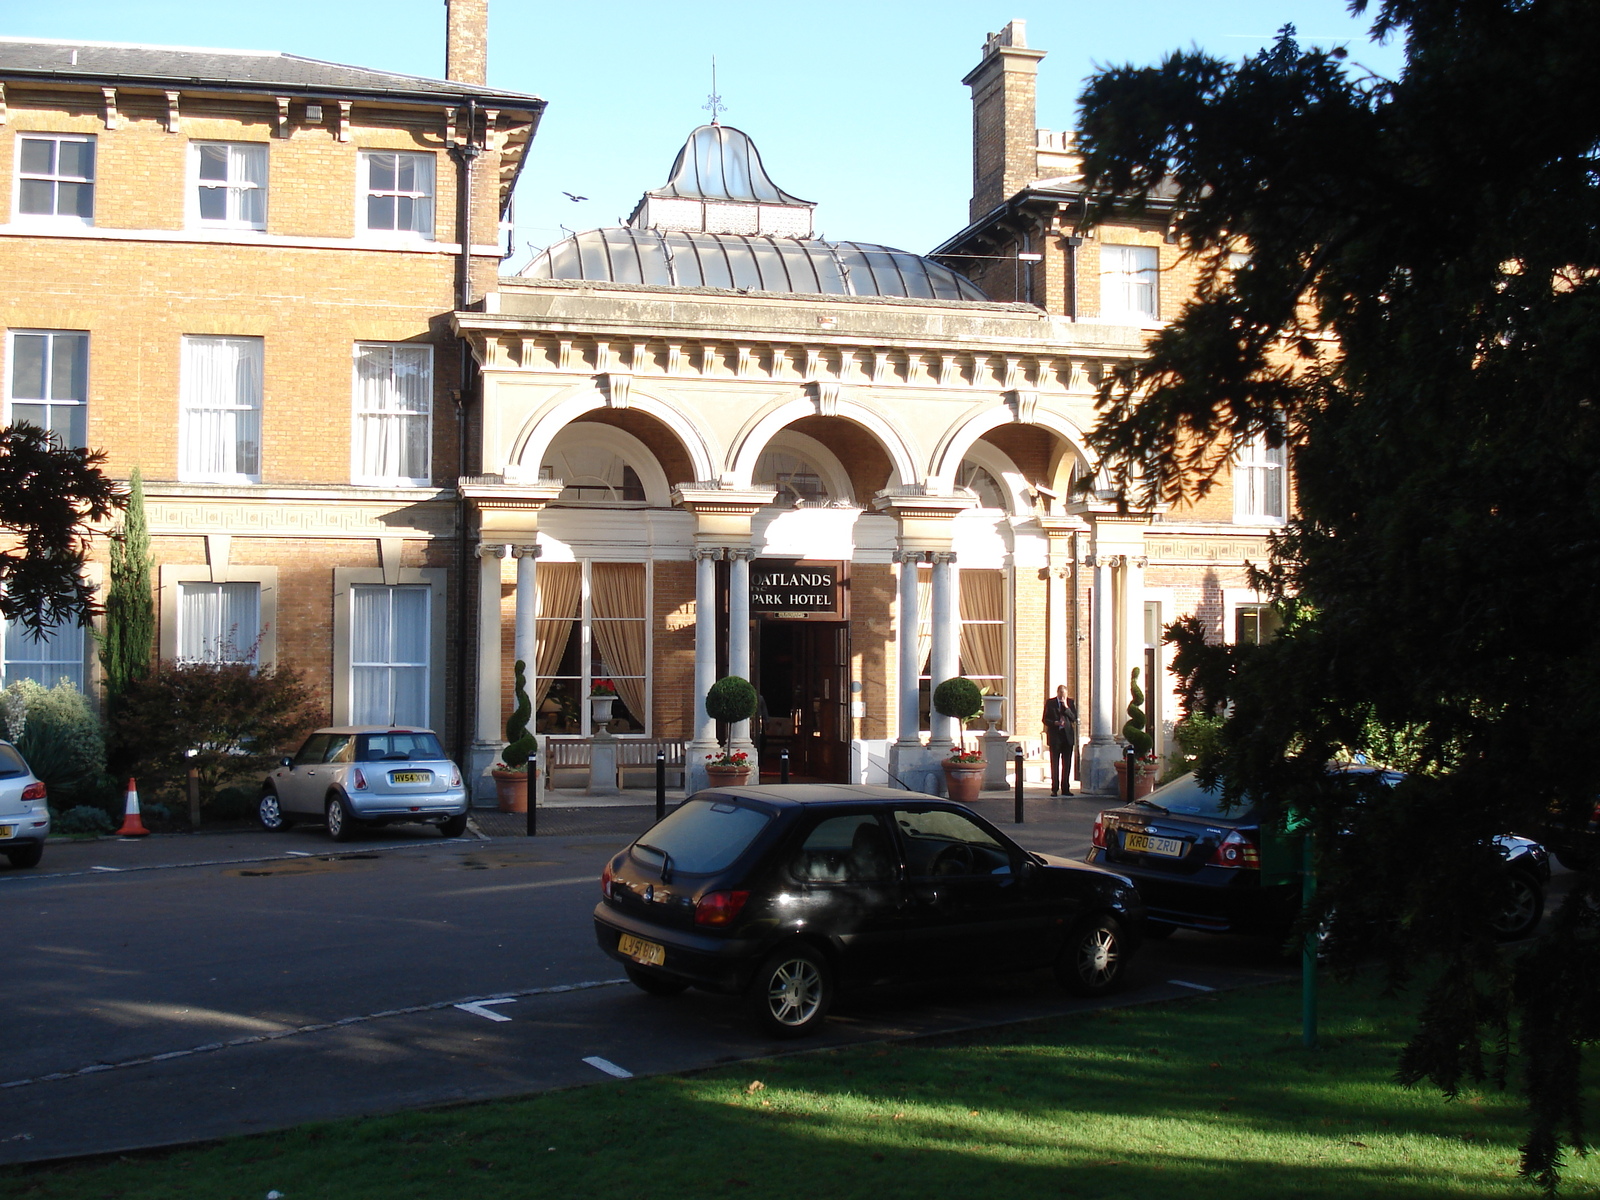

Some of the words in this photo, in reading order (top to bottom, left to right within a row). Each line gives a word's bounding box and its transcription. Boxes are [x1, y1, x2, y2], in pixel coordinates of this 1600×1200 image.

[751, 573, 831, 586] OATLANDS
[751, 594, 783, 605] PARK
[789, 594, 832, 605] HOTEL
[1129, 834, 1155, 849] KR06
[1156, 838, 1178, 853] ZRU
